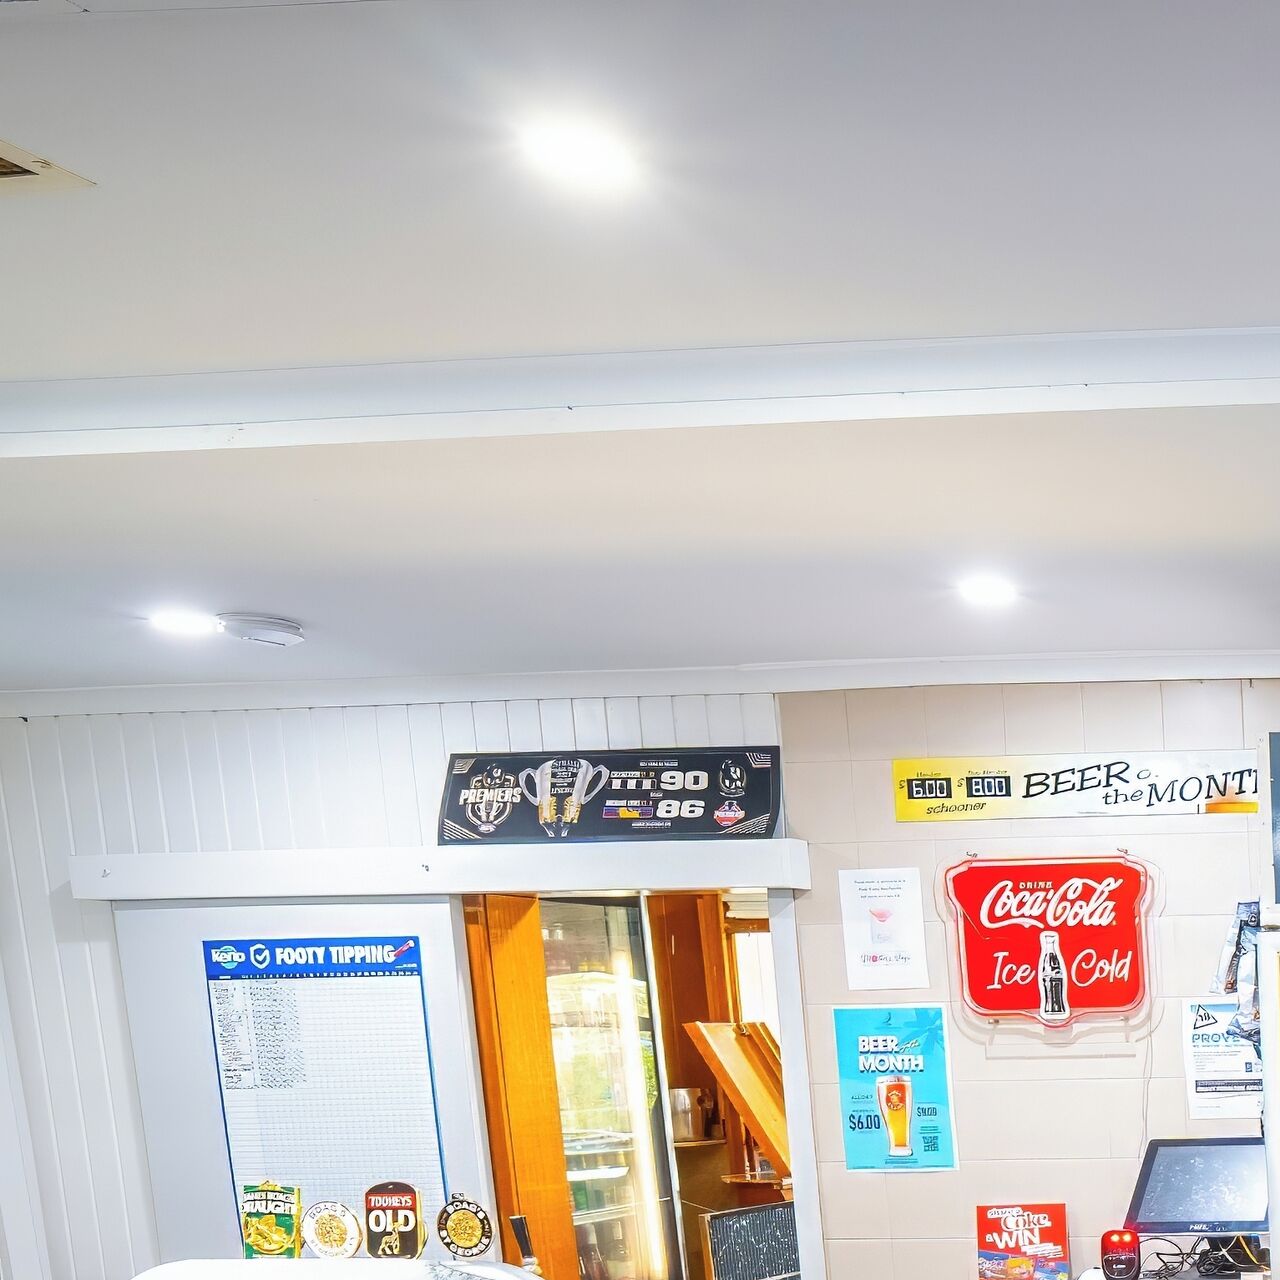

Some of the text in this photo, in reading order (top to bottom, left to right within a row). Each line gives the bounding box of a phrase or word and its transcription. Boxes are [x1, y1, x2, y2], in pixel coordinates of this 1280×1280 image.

[660, 771, 709, 791] 90
[1022, 761, 1130, 798] BEER
[459, 787, 522, 805] PREMIERS
[1102, 789, 1143, 805] the
[656, 800, 705, 818] 86
[926, 802, 987, 815] schooner
[211, 948, 246, 963] Keno
[275, 945, 396, 965] FOOTY TIPPING
[986, 948, 1133, 990] Ice Cold
[858, 1035, 899, 1055] BEER
[859, 1054, 924, 1073] MONTH
[369, 1195, 413, 1207] TOOHEYS
[368, 1210, 417, 1233] OLD
[1001, 1212, 1050, 1231] Coke
[993, 1229, 1040, 1249] WIN
